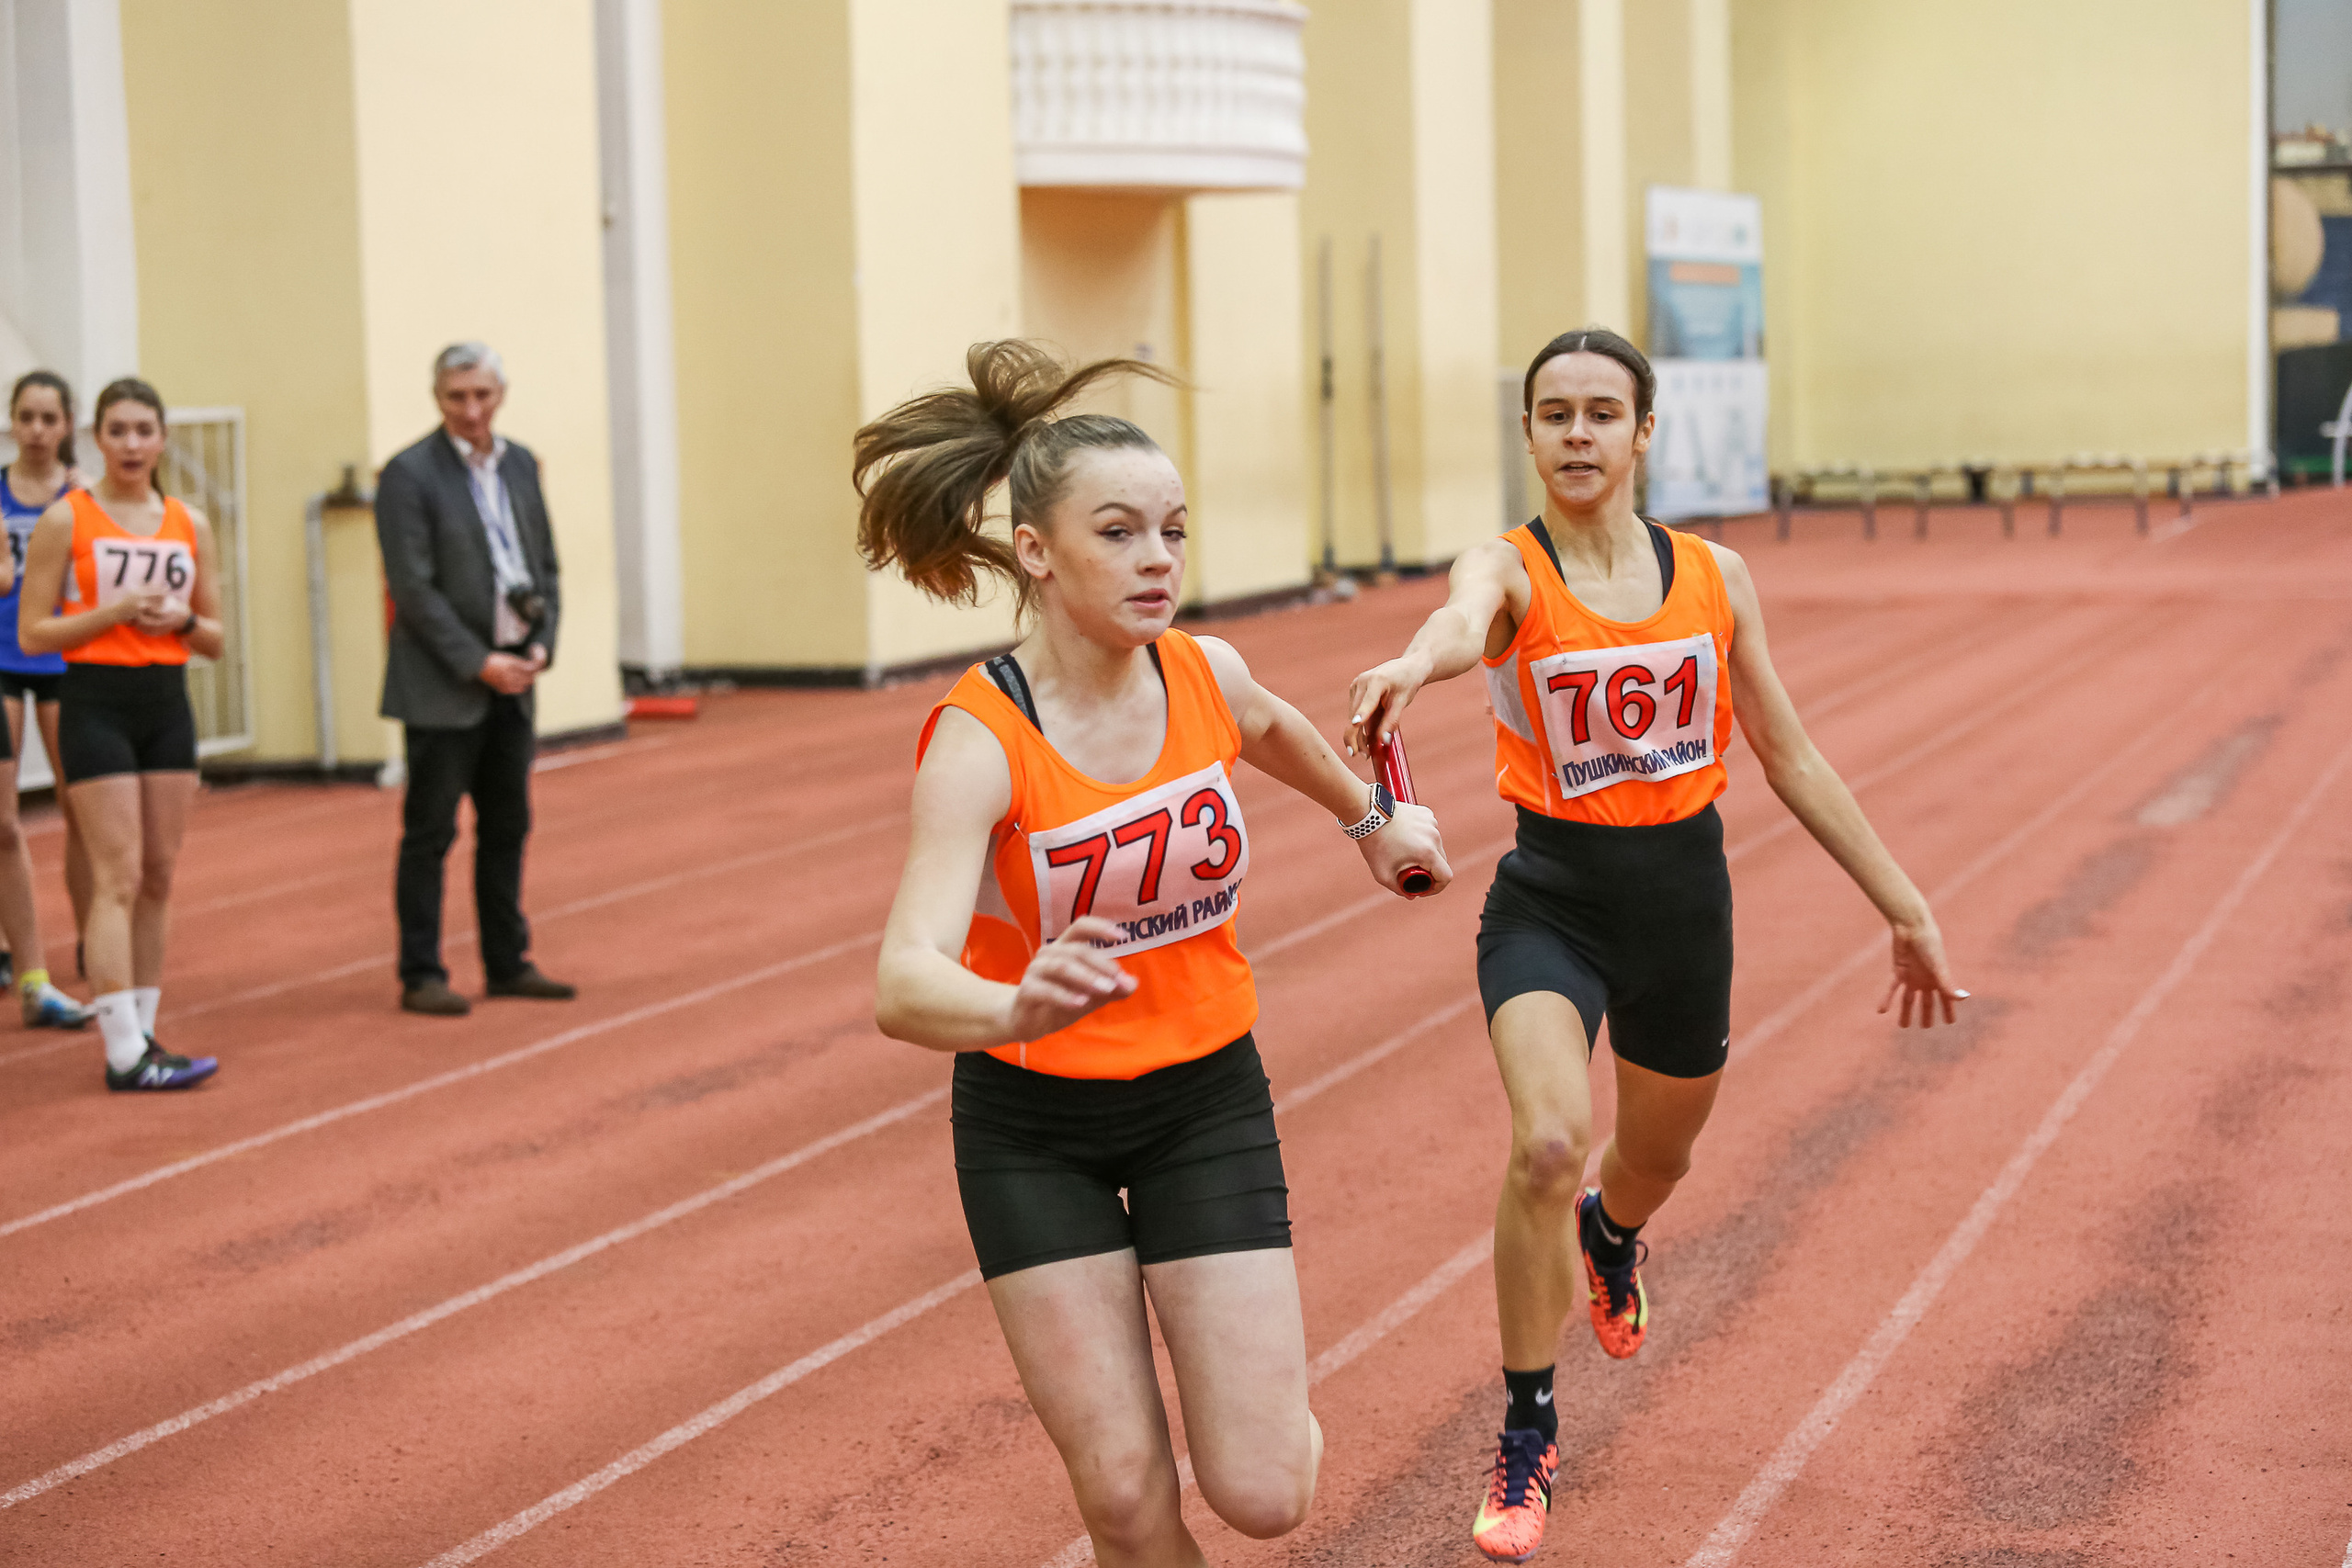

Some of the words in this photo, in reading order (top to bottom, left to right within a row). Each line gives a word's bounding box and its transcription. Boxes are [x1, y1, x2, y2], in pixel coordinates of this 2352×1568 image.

[105, 547, 187, 591] 776
[1547, 655, 1699, 746] 761
[1563, 749, 1665, 787] ПУШКИНСКИЙ
[1661, 739, 1707, 769] РАЙОН
[1046, 787, 1242, 924] 773
[1046, 903, 1189, 949] ИНСКИЙ
